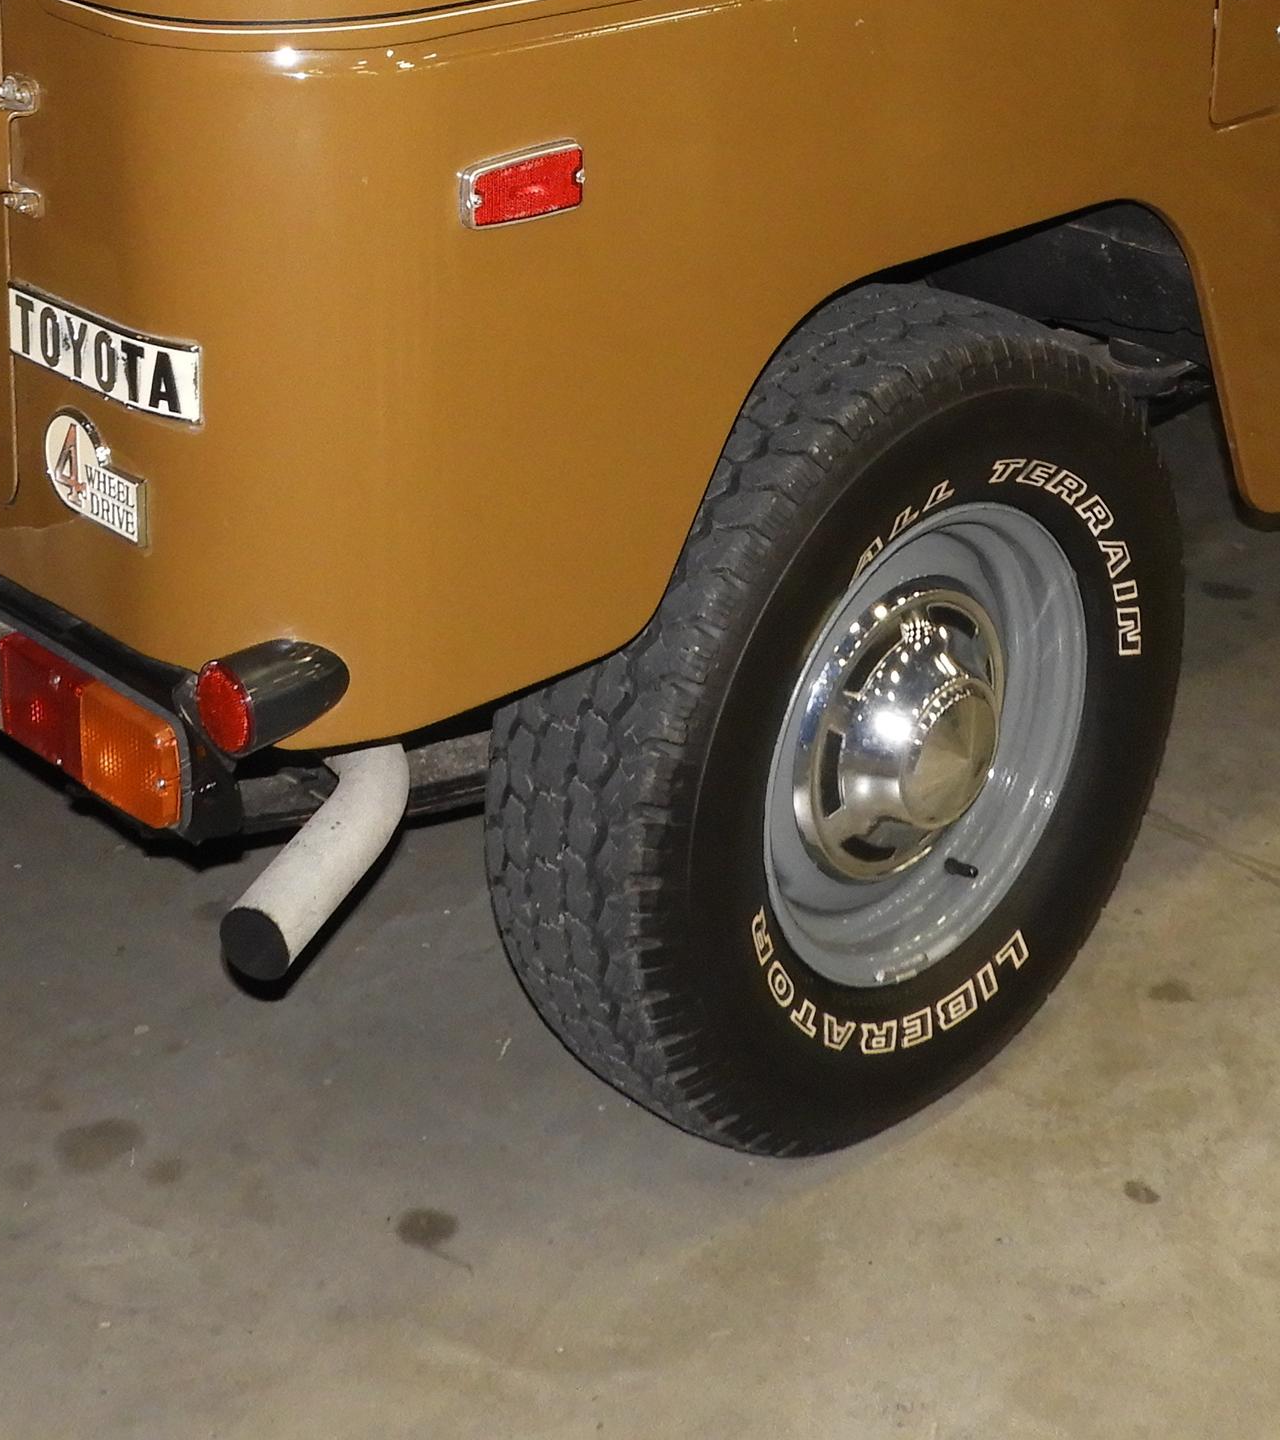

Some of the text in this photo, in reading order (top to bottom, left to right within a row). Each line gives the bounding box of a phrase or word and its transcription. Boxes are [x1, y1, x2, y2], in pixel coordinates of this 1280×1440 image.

[15, 294, 182, 415] TOYOTA
[54, 422, 88, 508] 4
[84, 463, 136, 509] WHEEL
[89, 491, 136, 536] DRIVE
[848, 458, 1142, 656] ALL TERRAIN
[750, 905, 1030, 1055] LIBERATOR
